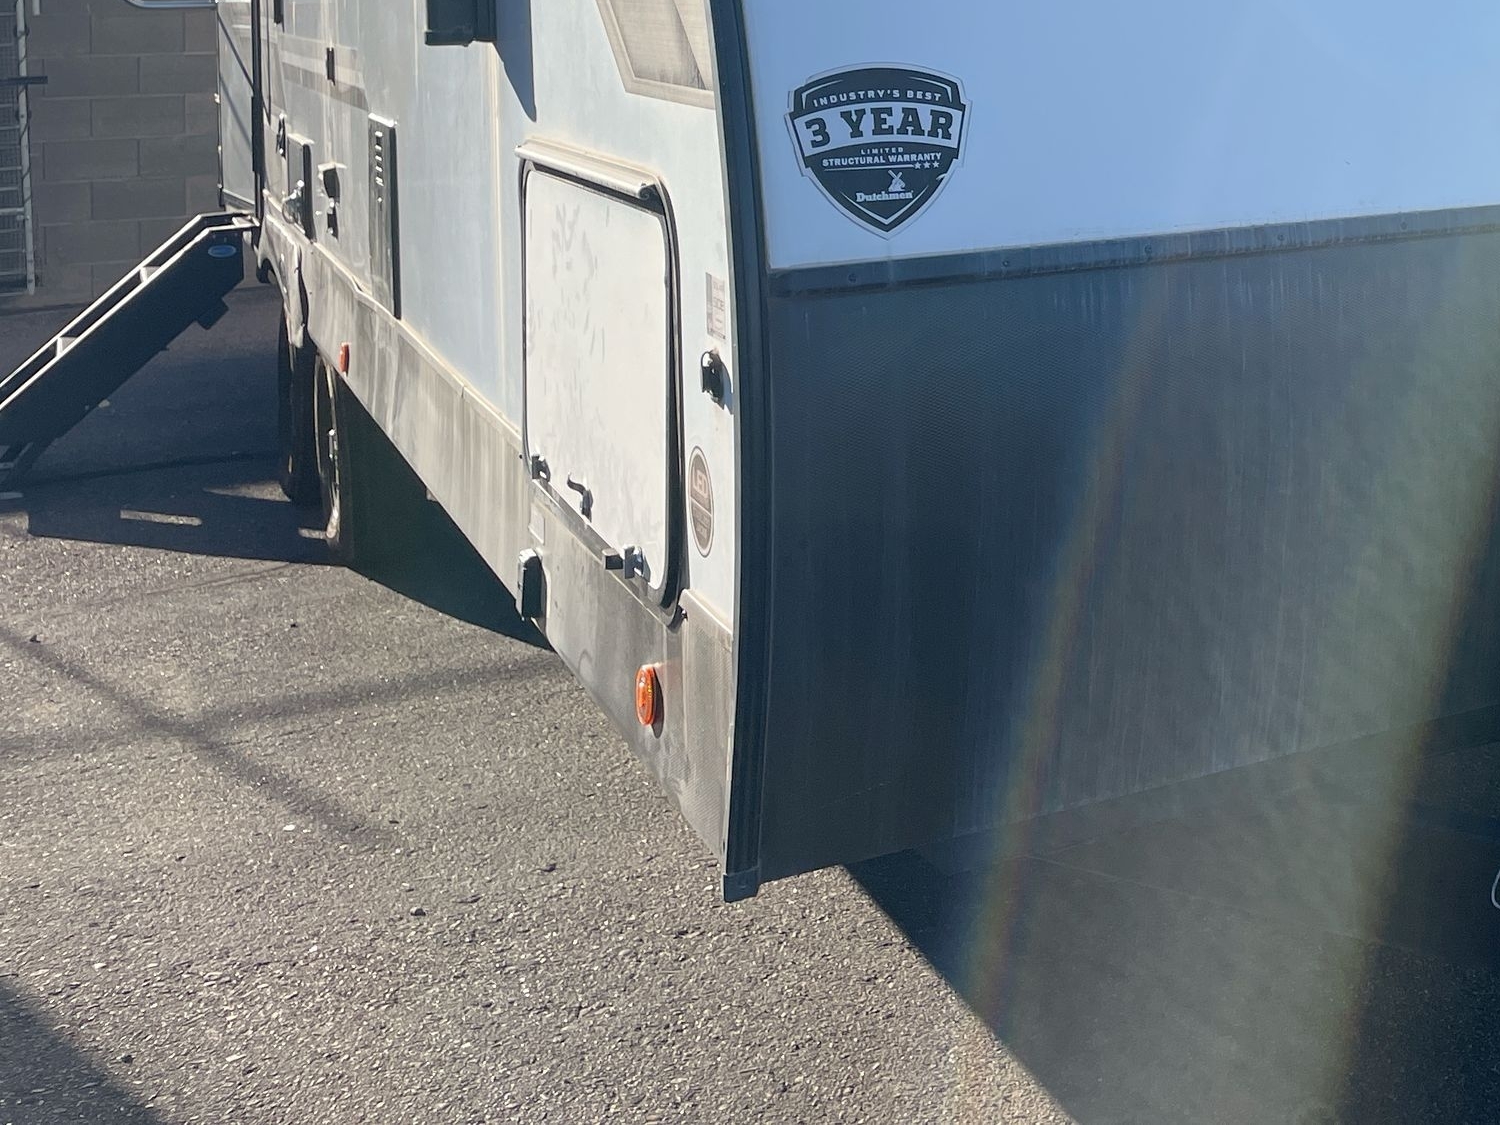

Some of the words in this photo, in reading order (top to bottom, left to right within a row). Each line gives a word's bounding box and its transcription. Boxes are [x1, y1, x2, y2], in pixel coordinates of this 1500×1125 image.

[814, 90, 900, 107] INDUSTRY'S
[907, 90, 942, 102] BEST
[805, 117, 831, 148] 3
[840, 107, 953, 140] YEAR
[861, 147, 904, 155] LIMITED
[822, 155, 886, 167] STRUCTURAL
[888, 152, 942, 163] WARRANTY
[856, 190, 914, 203] Dutchmen
